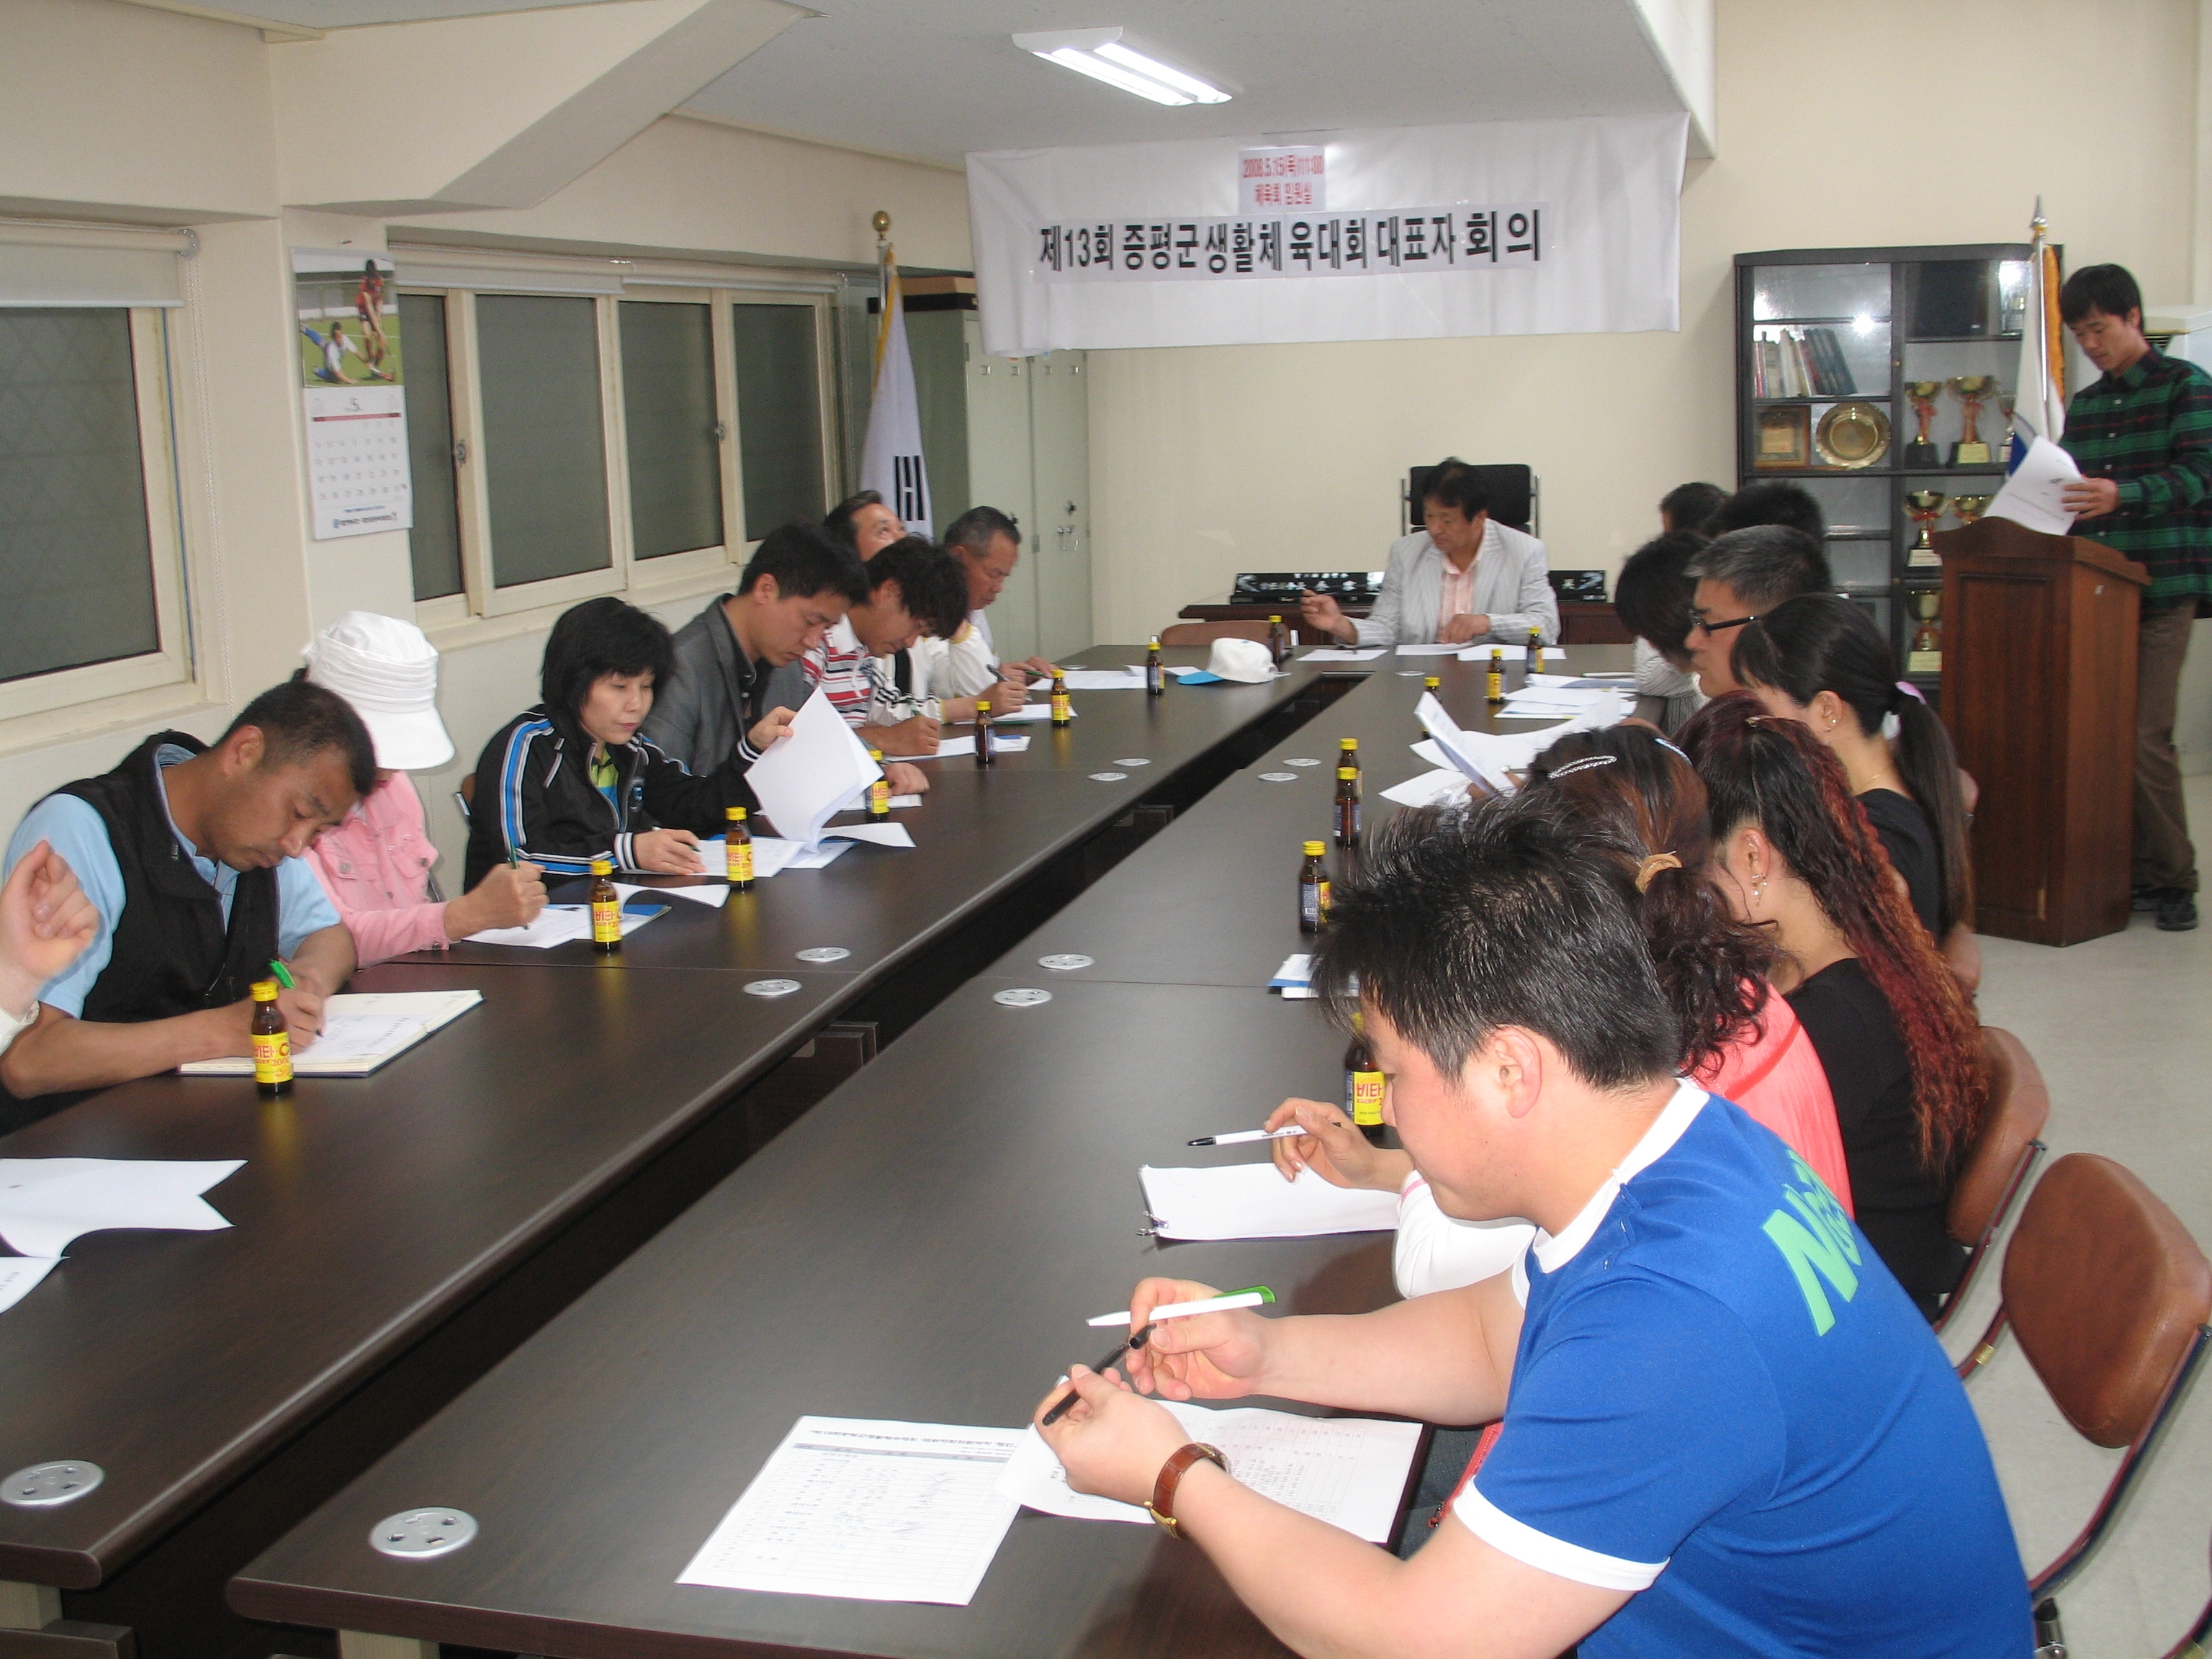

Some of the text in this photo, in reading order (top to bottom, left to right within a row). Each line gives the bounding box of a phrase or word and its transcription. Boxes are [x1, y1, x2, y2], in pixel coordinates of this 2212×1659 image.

[1255, 183, 1282, 206] 체육회
[1040, 224, 1115, 271] 제13회
[1123, 222, 1200, 270] 증평군
